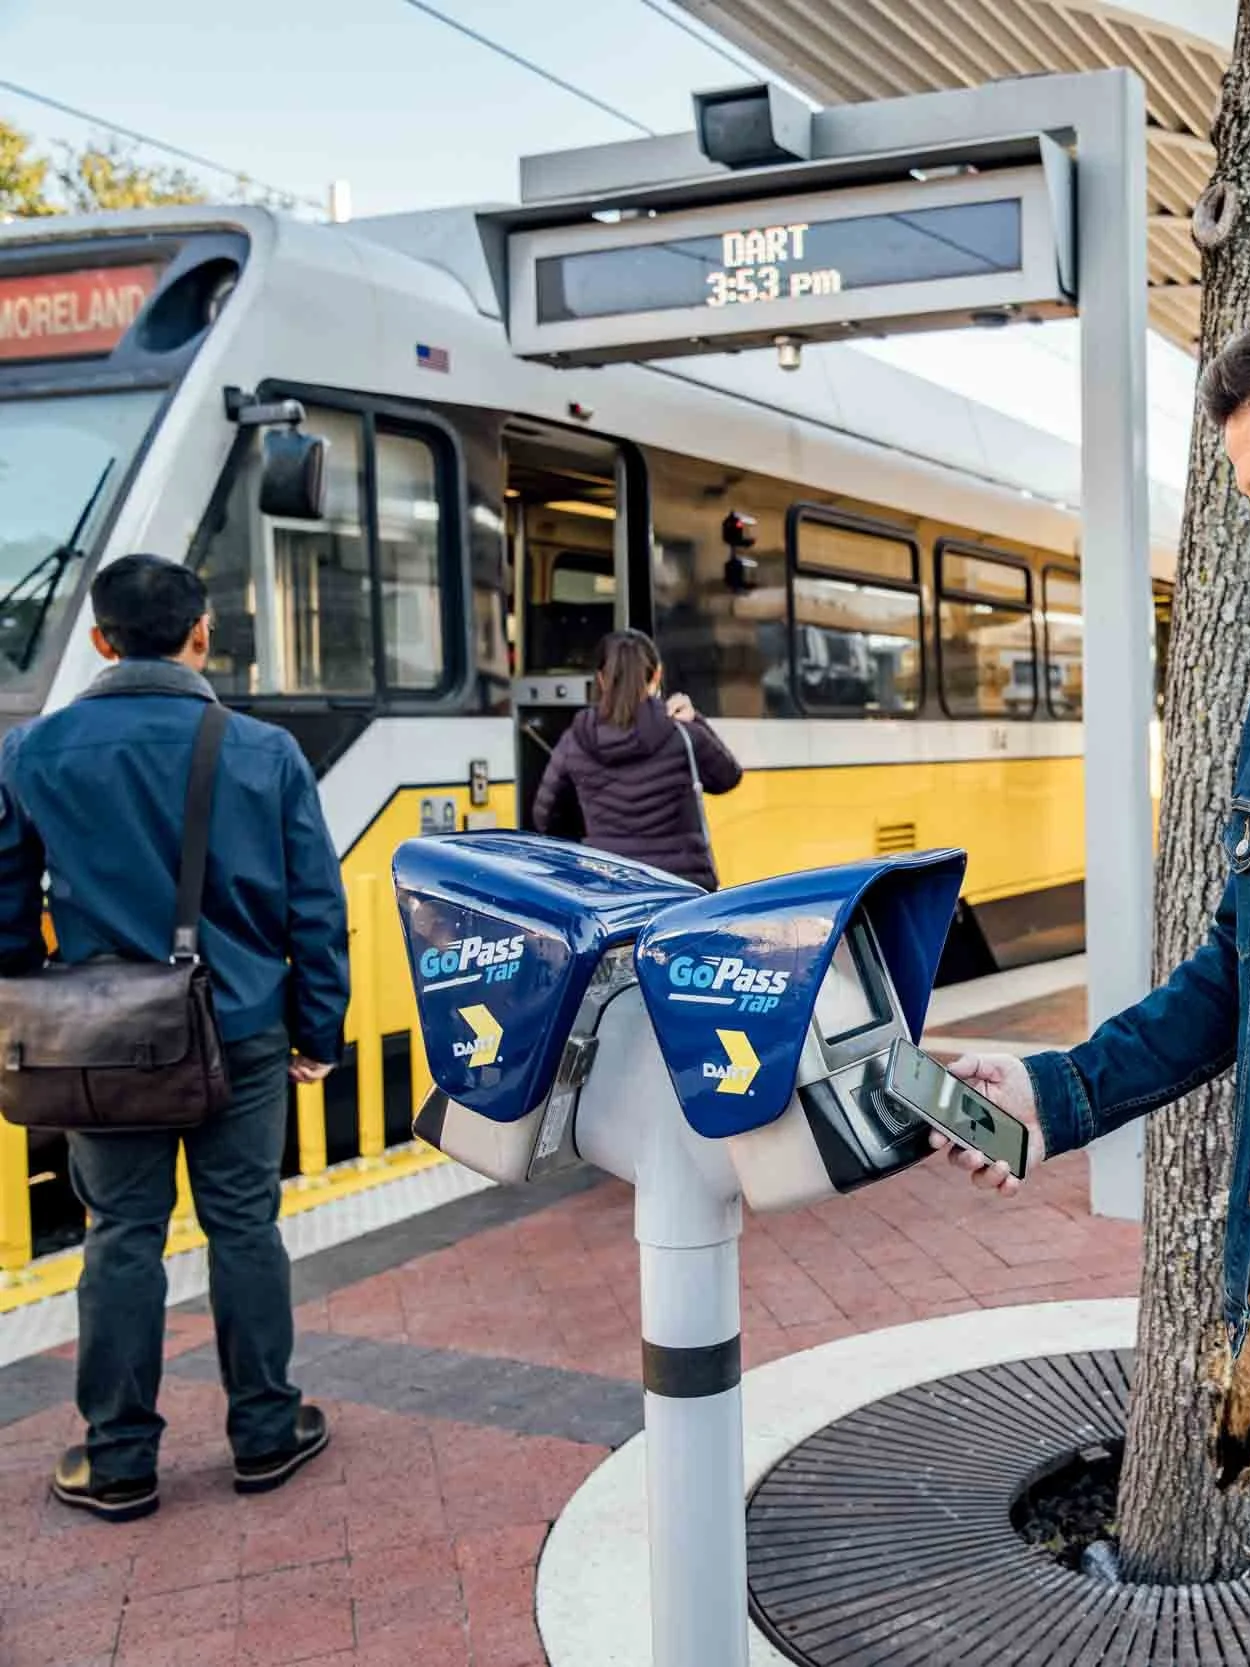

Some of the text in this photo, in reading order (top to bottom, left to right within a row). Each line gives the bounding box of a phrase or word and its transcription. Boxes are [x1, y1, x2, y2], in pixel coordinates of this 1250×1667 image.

[722, 223, 809, 268] DART
[705, 265, 780, 307] 3:53
[420, 935, 525, 978] GoPass
[669, 955, 791, 995] GoPass
[702, 1062, 753, 1081] DART
